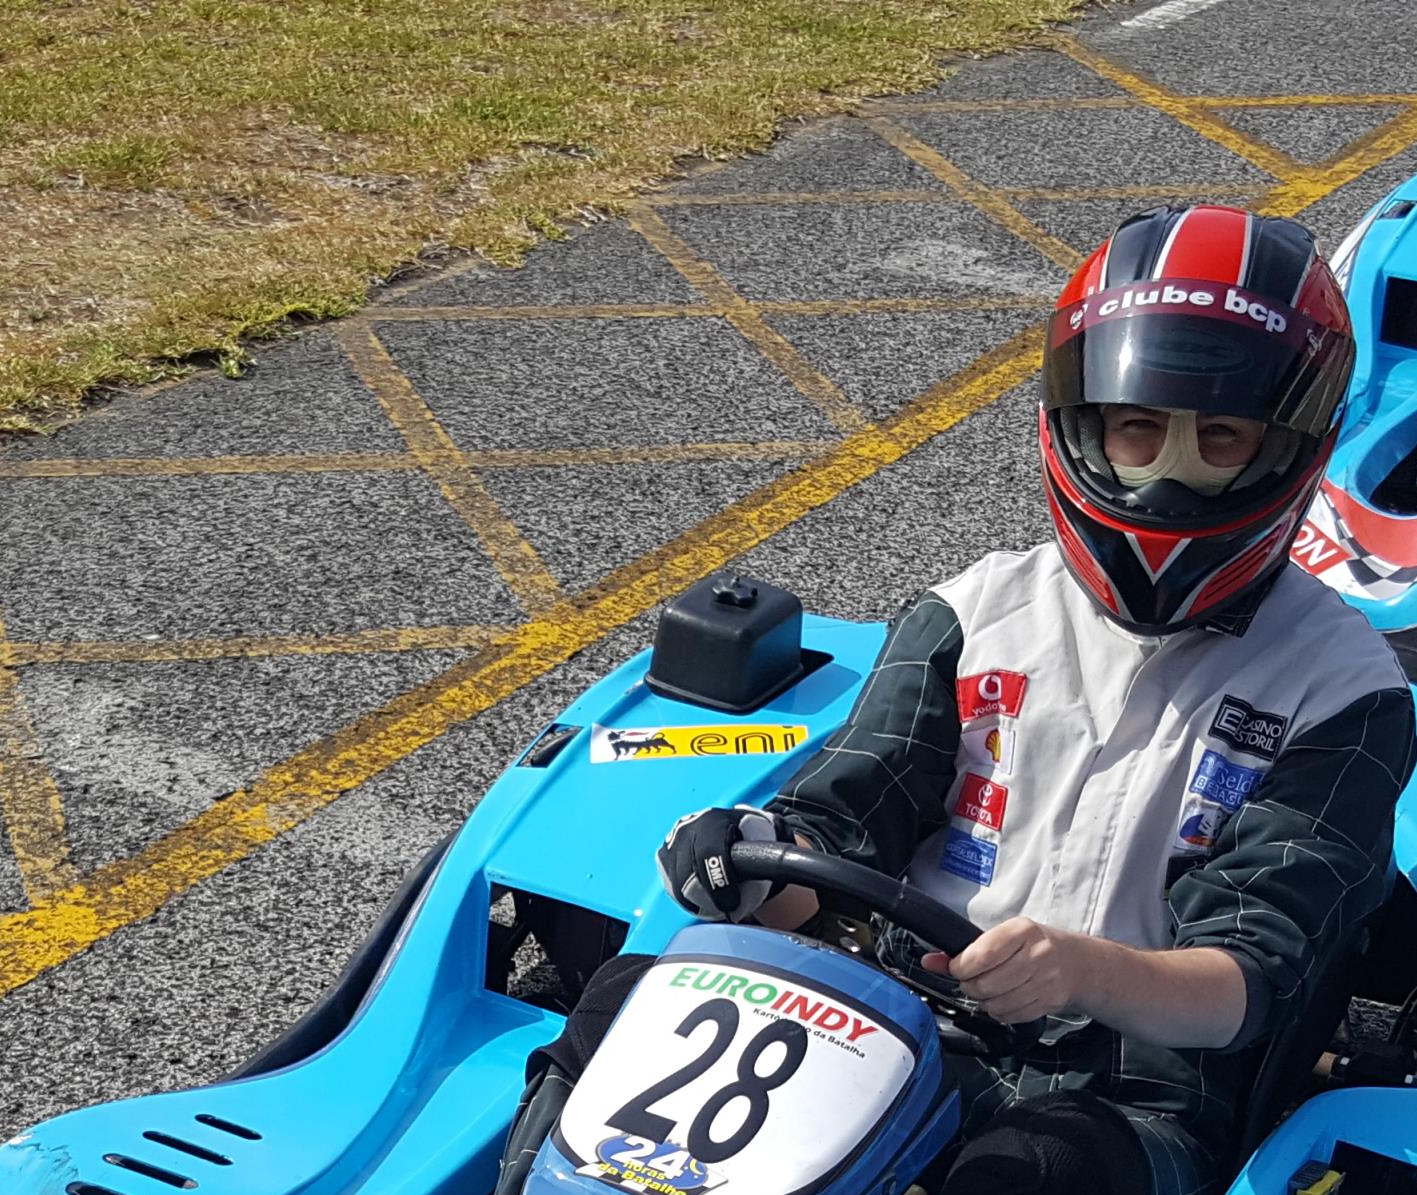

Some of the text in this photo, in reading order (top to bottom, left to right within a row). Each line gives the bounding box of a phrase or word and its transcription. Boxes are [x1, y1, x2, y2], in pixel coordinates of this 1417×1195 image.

[1098, 286, 1287, 333] clube bcp
[690, 725, 796, 756] eni
[708, 856, 725, 888] OMP
[669, 967, 879, 1042] EUROINDY
[813, 1029, 826, 1040] da
[827, 1035, 866, 1059] Batalha
[604, 998, 808, 1164] 28
[598, 1162, 619, 1176] da
[610, 1135, 690, 1180] 24
[623, 1160, 666, 1181] horas
